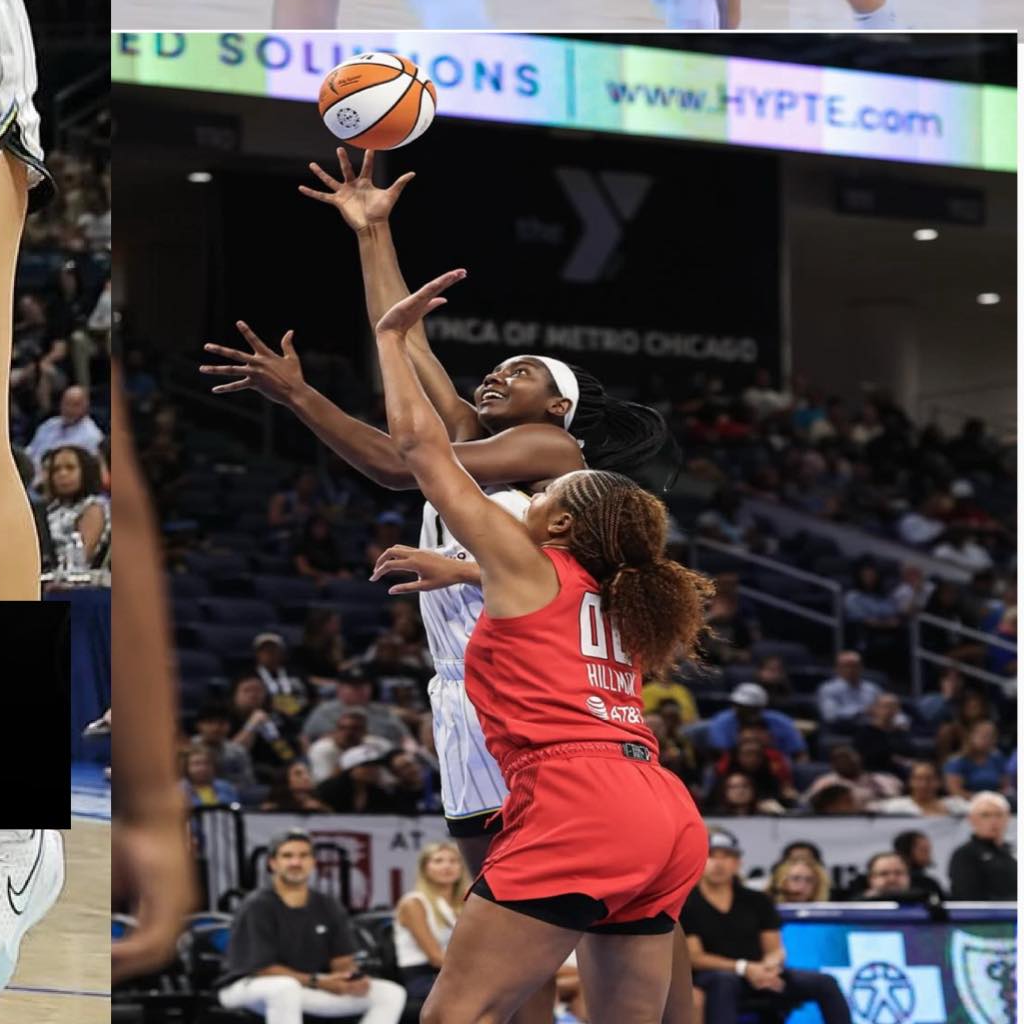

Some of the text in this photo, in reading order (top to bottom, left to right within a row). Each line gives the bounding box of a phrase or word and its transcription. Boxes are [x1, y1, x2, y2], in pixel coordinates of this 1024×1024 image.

[219, 33, 541, 97] SOLONS
[605, 80, 944, 138] www.HYPTE.com
[503, 321, 540, 347] OF
[544, 324, 640, 355] METRO
[644, 330, 759, 363] CHICAGO
